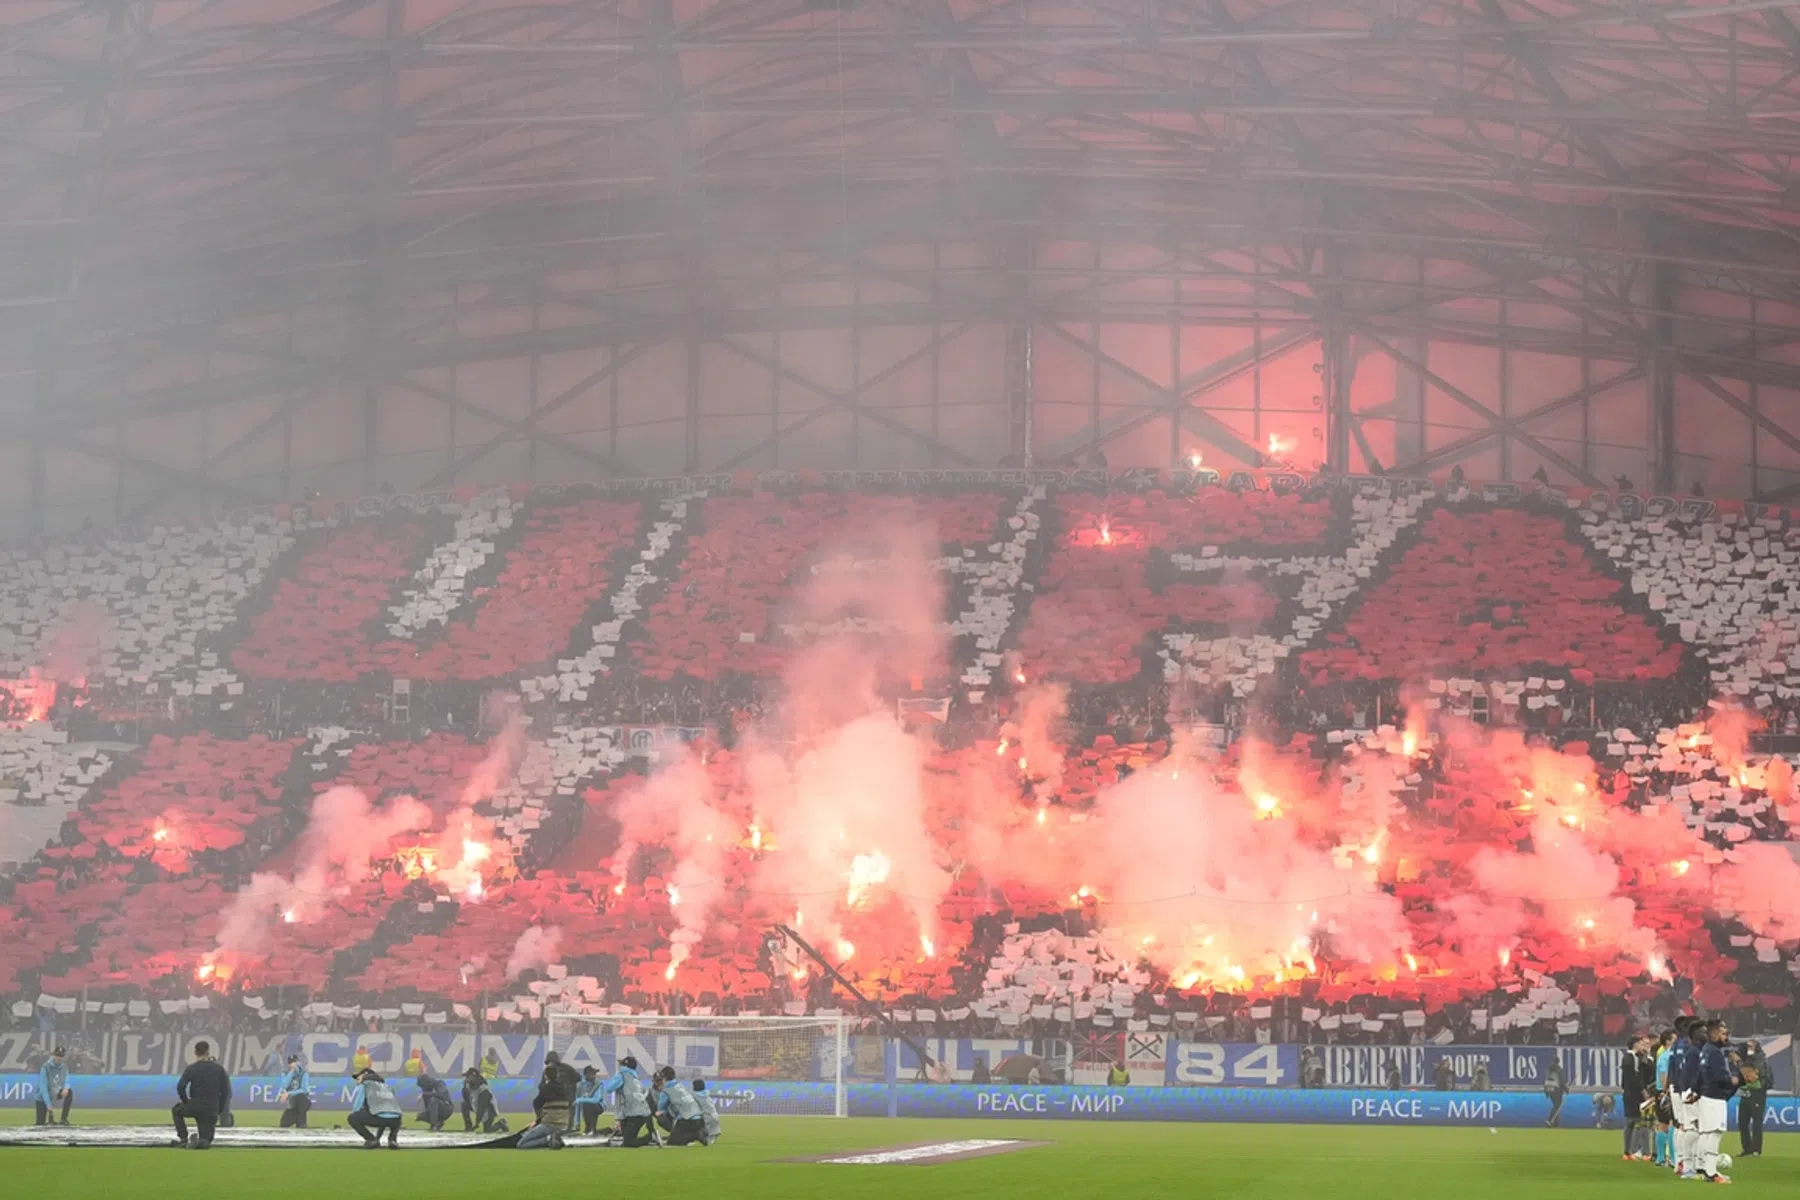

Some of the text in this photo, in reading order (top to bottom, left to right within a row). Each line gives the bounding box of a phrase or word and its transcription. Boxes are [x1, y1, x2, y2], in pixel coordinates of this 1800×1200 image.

[1176, 1042, 1284, 1085] 84
[1303, 1046, 1425, 1087] IBERTE
[1508, 1047, 1537, 1079] les
[0, 1082, 33, 1100] ИР
[977, 1093, 1046, 1112] PEACE
[1070, 1095, 1124, 1113] МИР
[1352, 1098, 1422, 1117] PEACE
[1448, 1100, 1501, 1119] МИР
